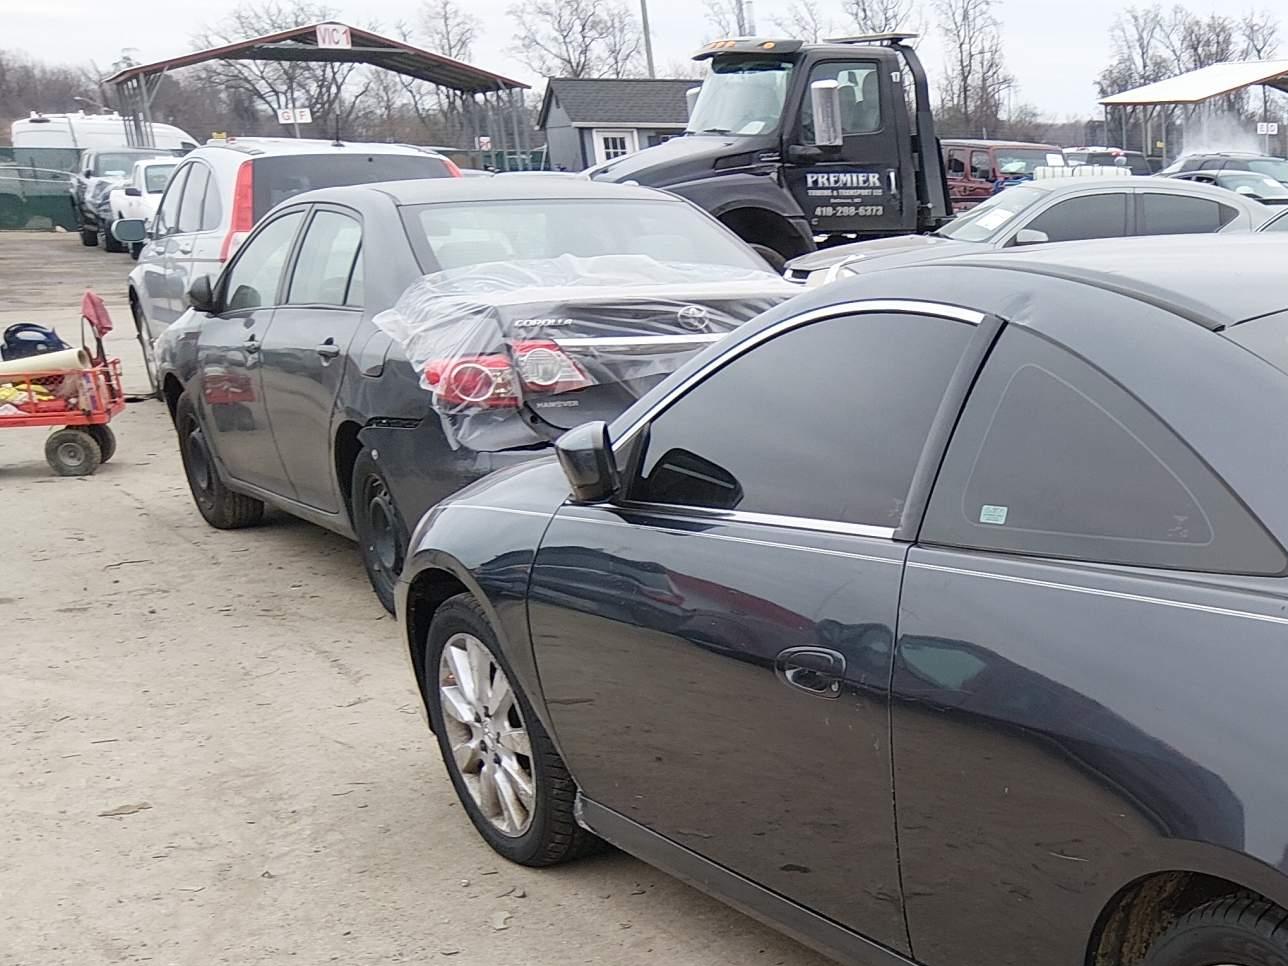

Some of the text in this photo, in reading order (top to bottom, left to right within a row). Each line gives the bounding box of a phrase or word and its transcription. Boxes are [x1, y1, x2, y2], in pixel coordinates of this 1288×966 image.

[320, 28, 350, 45] VIC 1
[281, 110, 291, 121] G
[806, 172, 881, 188] PREMIER
[513, 318, 574, 327] COROLLA
